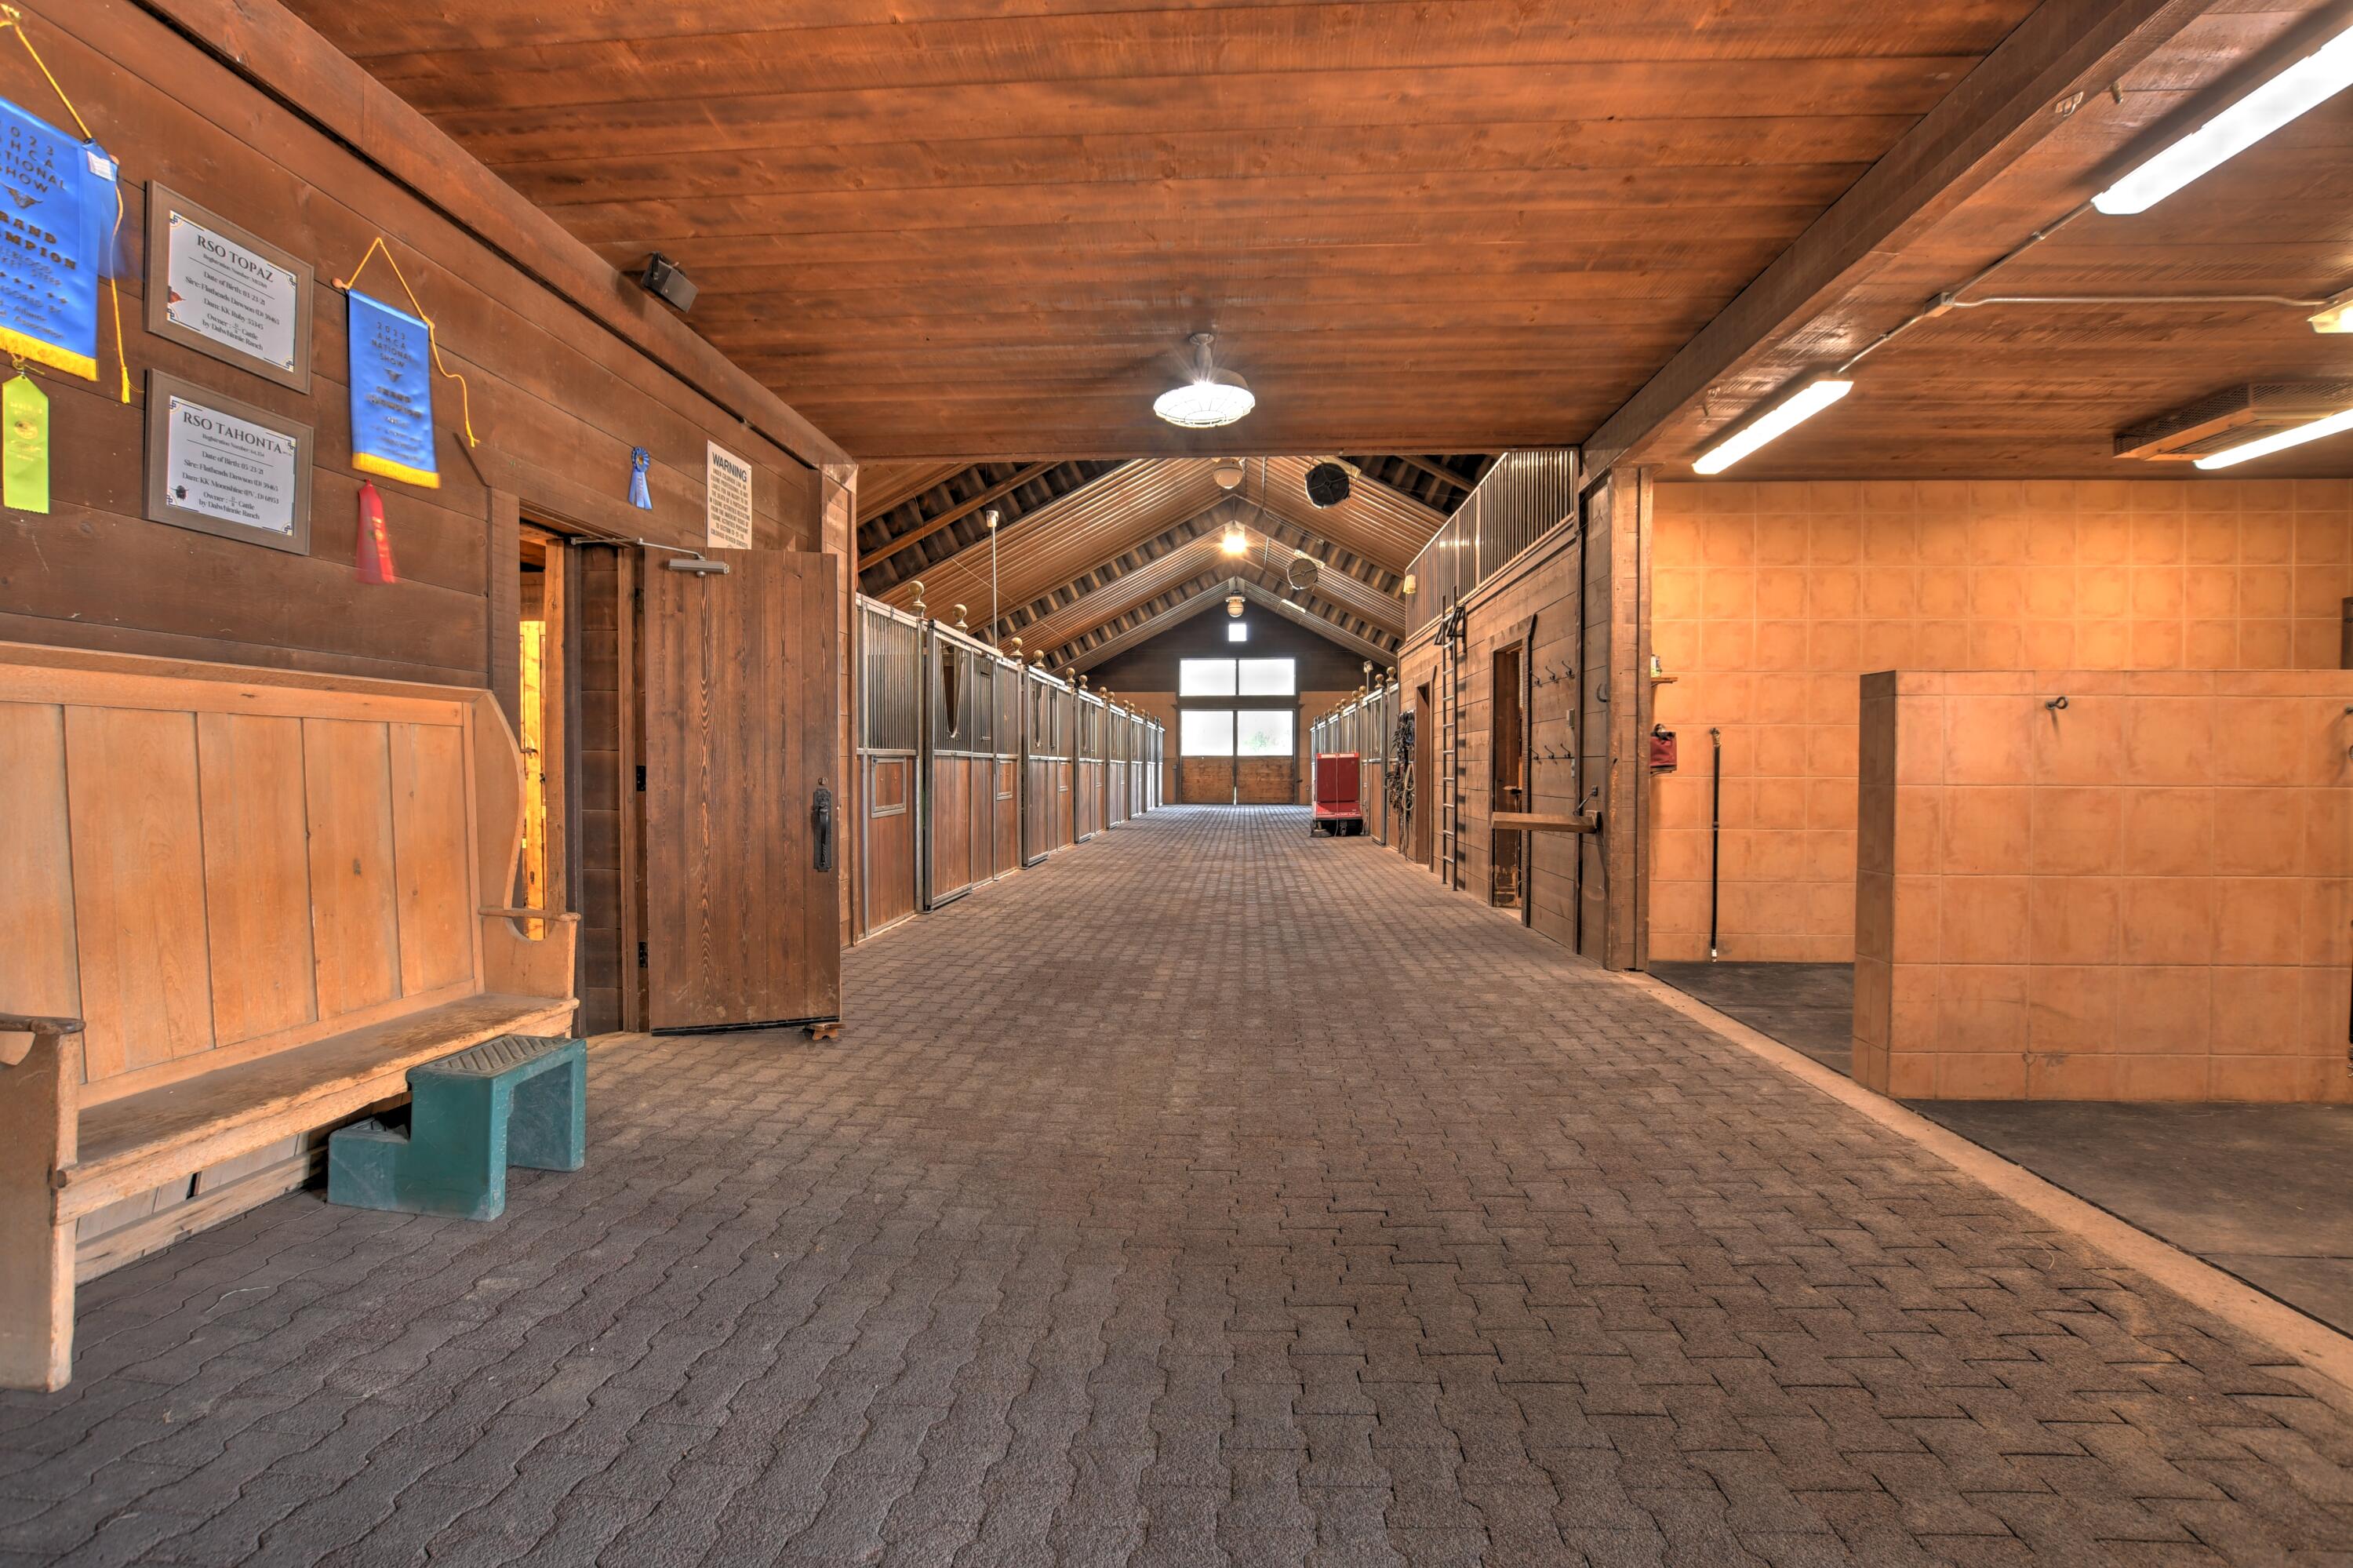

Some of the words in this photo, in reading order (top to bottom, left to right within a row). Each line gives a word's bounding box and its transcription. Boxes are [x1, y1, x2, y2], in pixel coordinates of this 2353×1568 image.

[0, 149, 65, 190] TIONAL
[0, 209, 57, 245] RAND
[2, 230, 77, 271] MPION
[197, 235, 226, 257] RSO
[229, 251, 274, 283] TOPAZ
[204, 271, 218, 283] Date
[202, 319, 209, 329] by
[245, 337, 264, 351] Ranch
[183, 411, 213, 431] RSO
[216, 421, 283, 454] TAHONTA
[202, 450, 216, 461] Date
[711, 451, 747, 483] WARNING
[229, 472, 253, 485] Dawson
[198, 498, 206, 508] by
[242, 510, 260, 519] Ranch
[238, 500, 255, 511] Cattle
